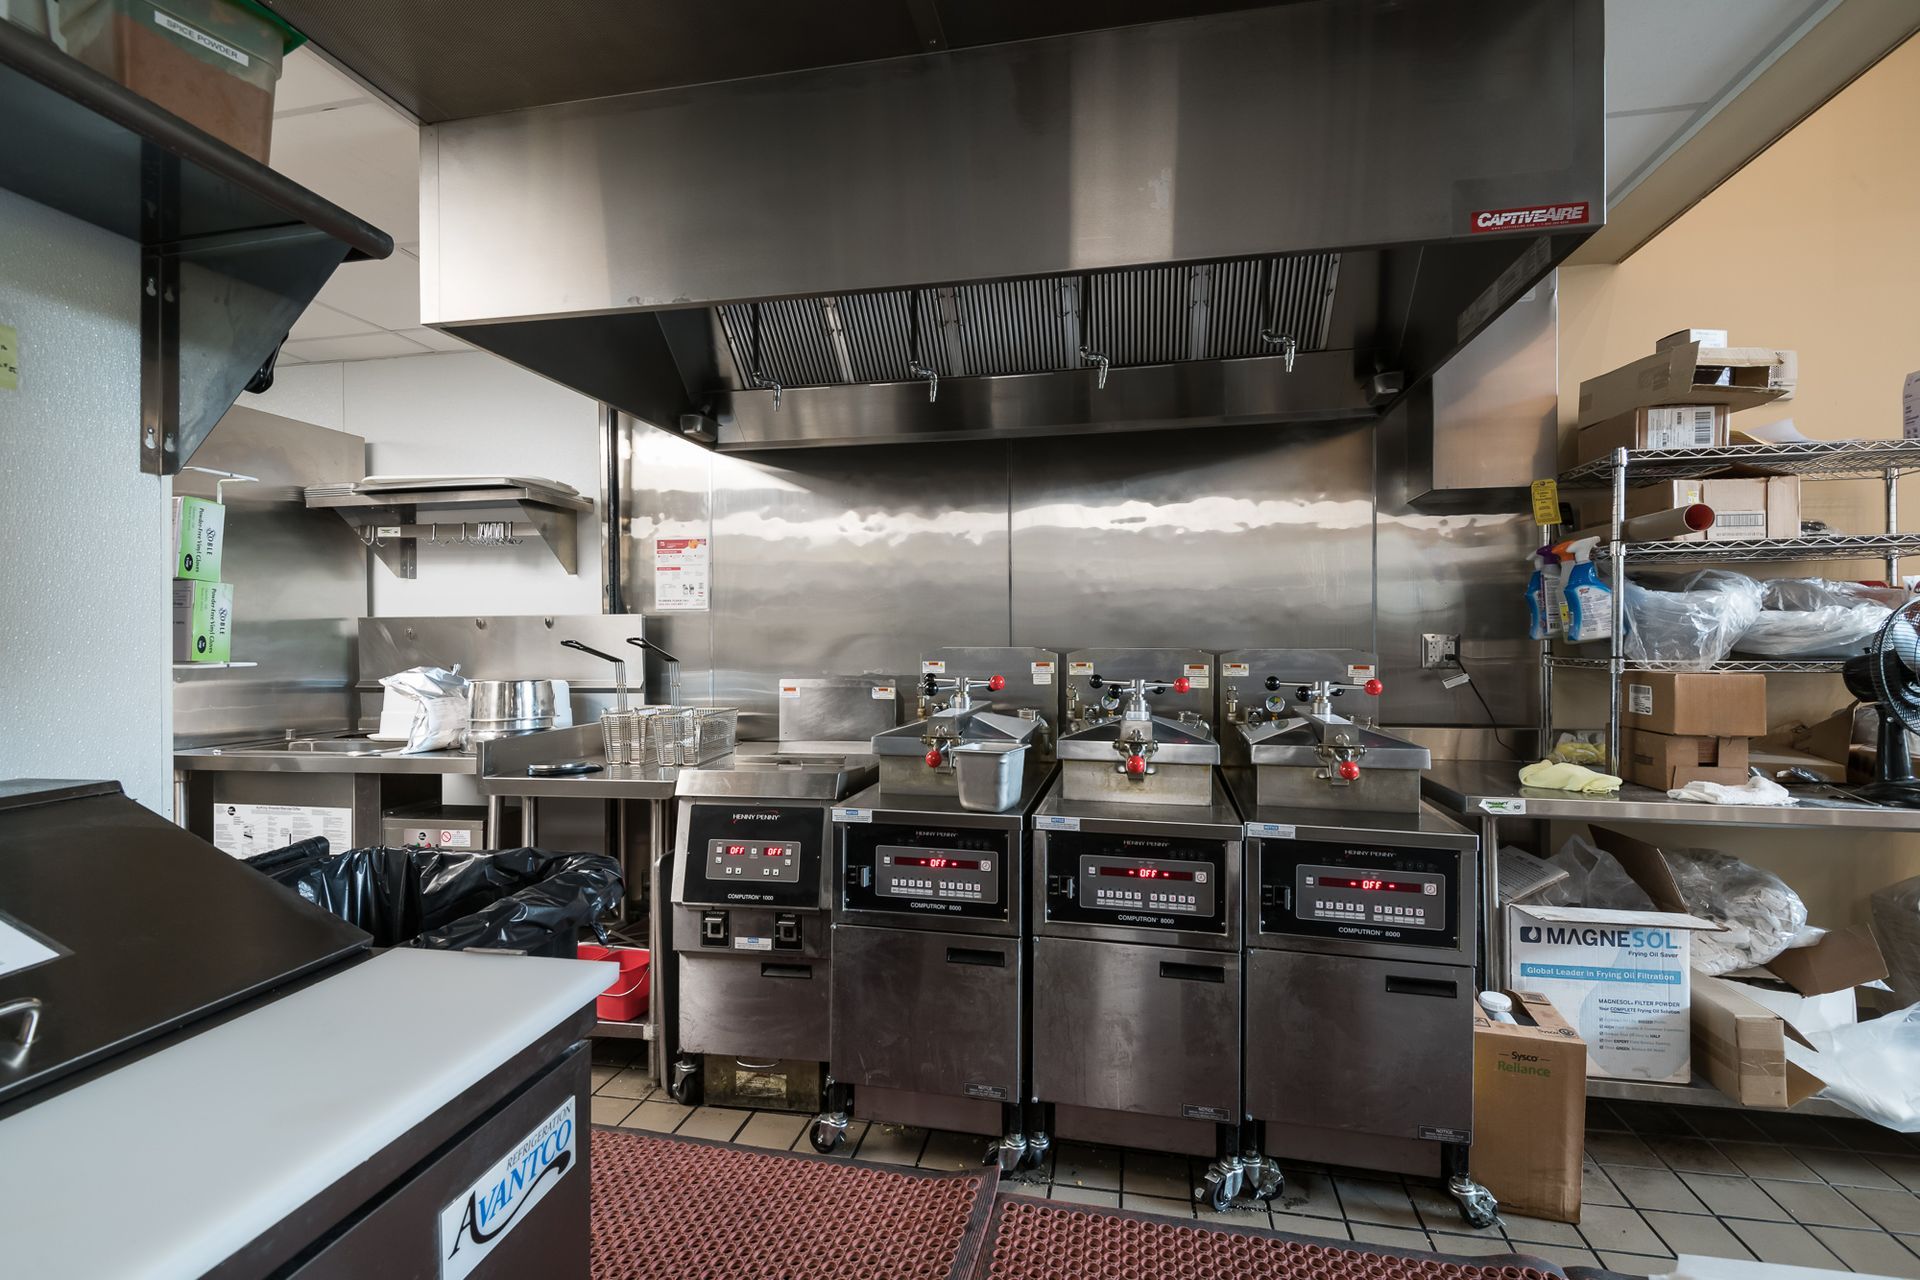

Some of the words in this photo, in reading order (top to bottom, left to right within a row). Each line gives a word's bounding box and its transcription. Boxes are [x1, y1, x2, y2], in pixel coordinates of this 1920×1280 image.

[166, 19, 195, 39] SPICE
[197, 34, 238, 59] POWDER
[206, 528, 216, 556] NOBLE
[219, 607, 228, 635] NOBLE
[730, 846, 745, 855] OFF
[767, 848, 782, 856] OFF
[910, 902, 946, 910] COMPUTRON
[1118, 914, 1157, 923] COMPUTRON
[1160, 917, 1175, 925] 8000
[1338, 926, 1381, 936] COMPUTRON
[1385, 929, 1401, 938] 8000
[1546, 927, 1678, 949] MAGNESOL
[1628, 950, 1648, 958] Frying
[1527, 966, 1554, 975] Global
[1556, 968, 1585, 977] Leader
[1596, 970, 1622, 980] Frying
[1623, 971, 1635, 979] Oil
[1637, 972, 1675, 981] Filtration
[1511, 1051, 1538, 1062] Sysco
[1497, 1060, 1551, 1078] Reliance
[506, 1103, 573, 1171] REFRIGERATION
[448, 1119, 572, 1260] AVANTCO
